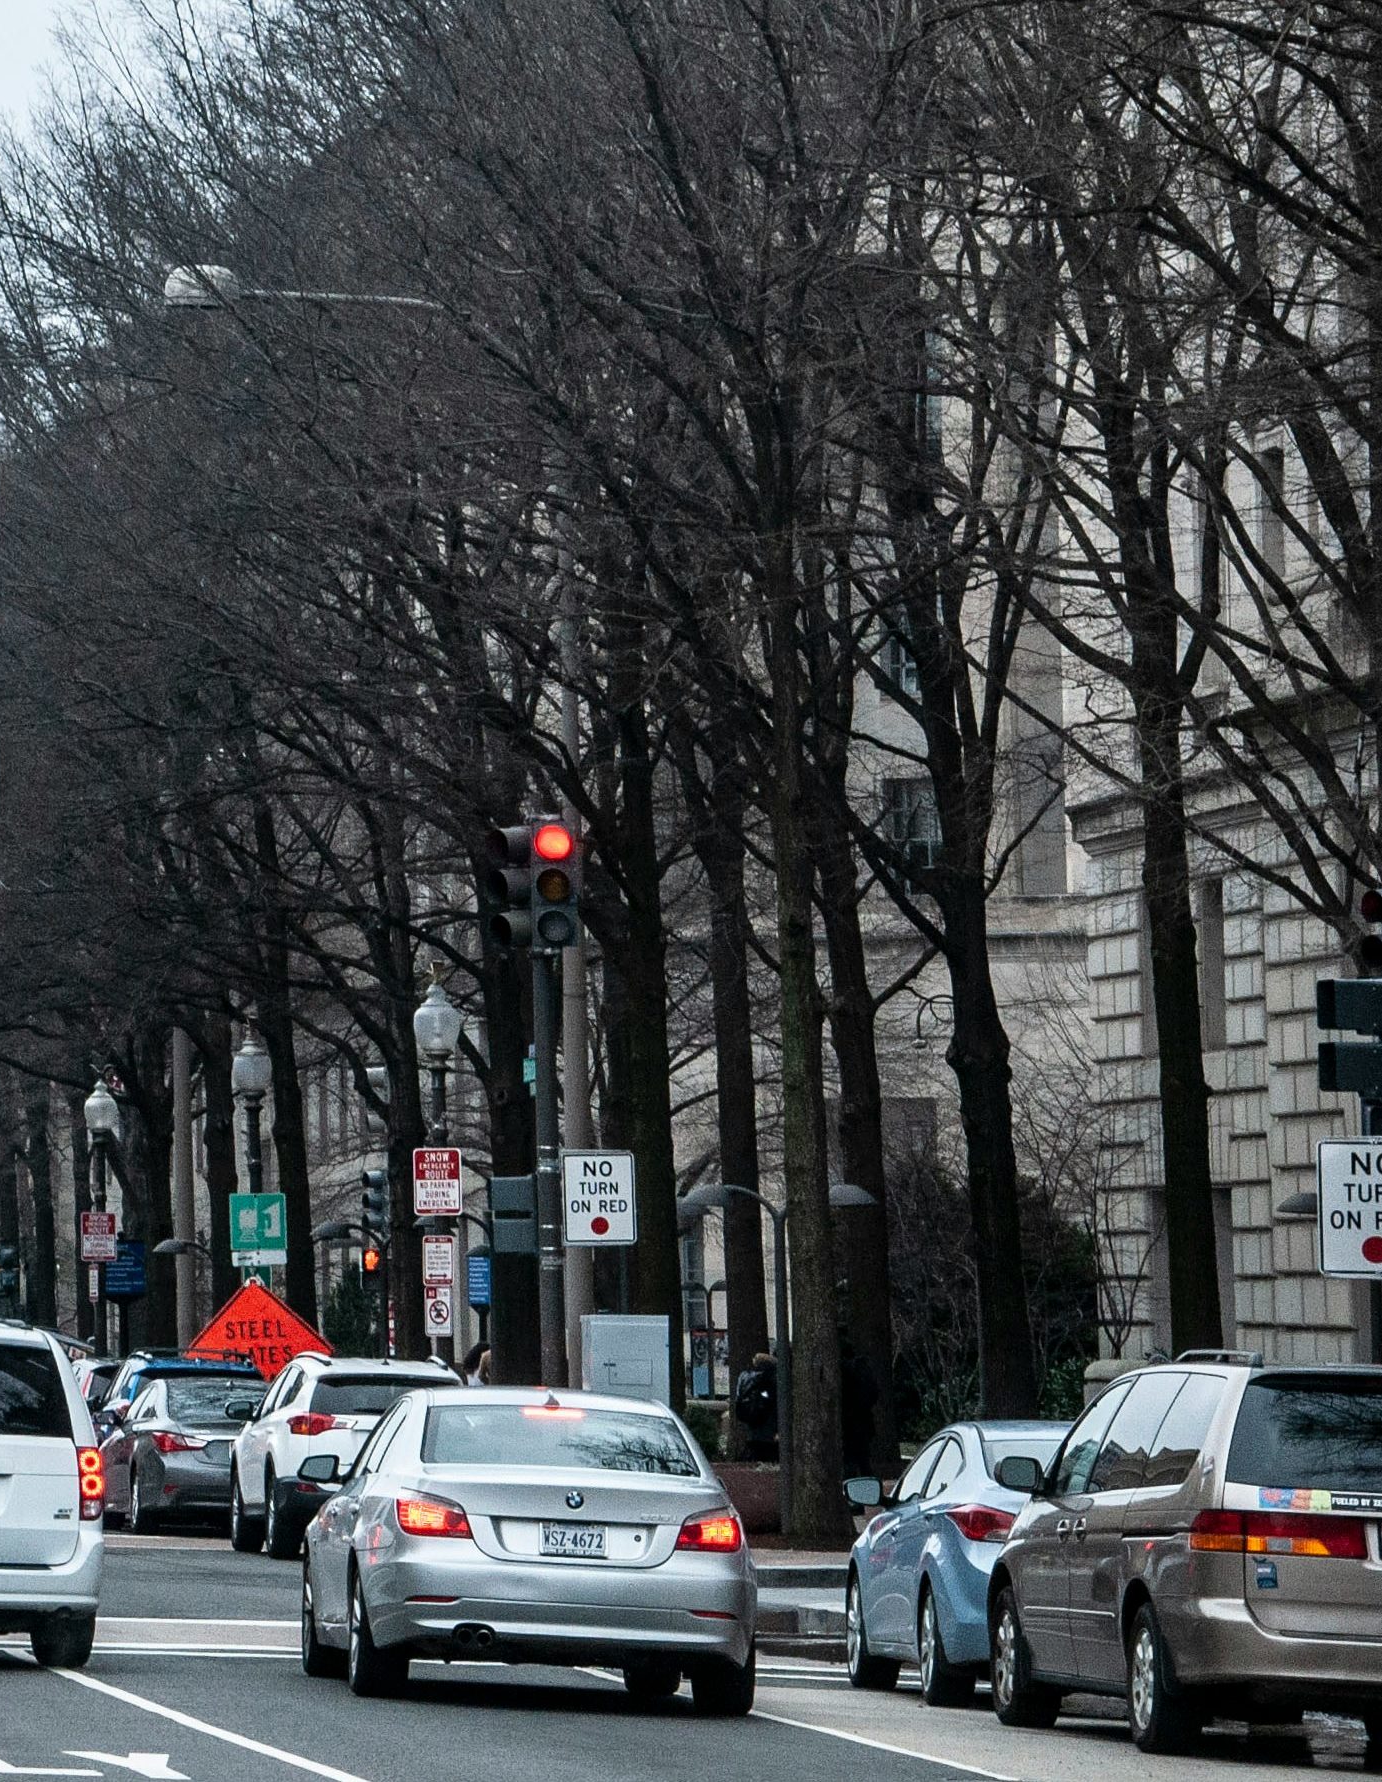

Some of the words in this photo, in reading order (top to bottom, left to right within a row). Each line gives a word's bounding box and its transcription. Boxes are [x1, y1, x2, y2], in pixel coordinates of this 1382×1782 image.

[425, 1152, 450, 1162] SNOW
[425, 1170, 449, 1179] ROUTE
[583, 1161, 612, 1177] NO
[425, 1190, 450, 1198] DURING
[579, 1182, 619, 1195] TURN
[571, 1200, 591, 1213] ON
[599, 1200, 628, 1213] RED
[1330, 1210, 1362, 1230] ON
[226, 1319, 286, 1340] STEEL
